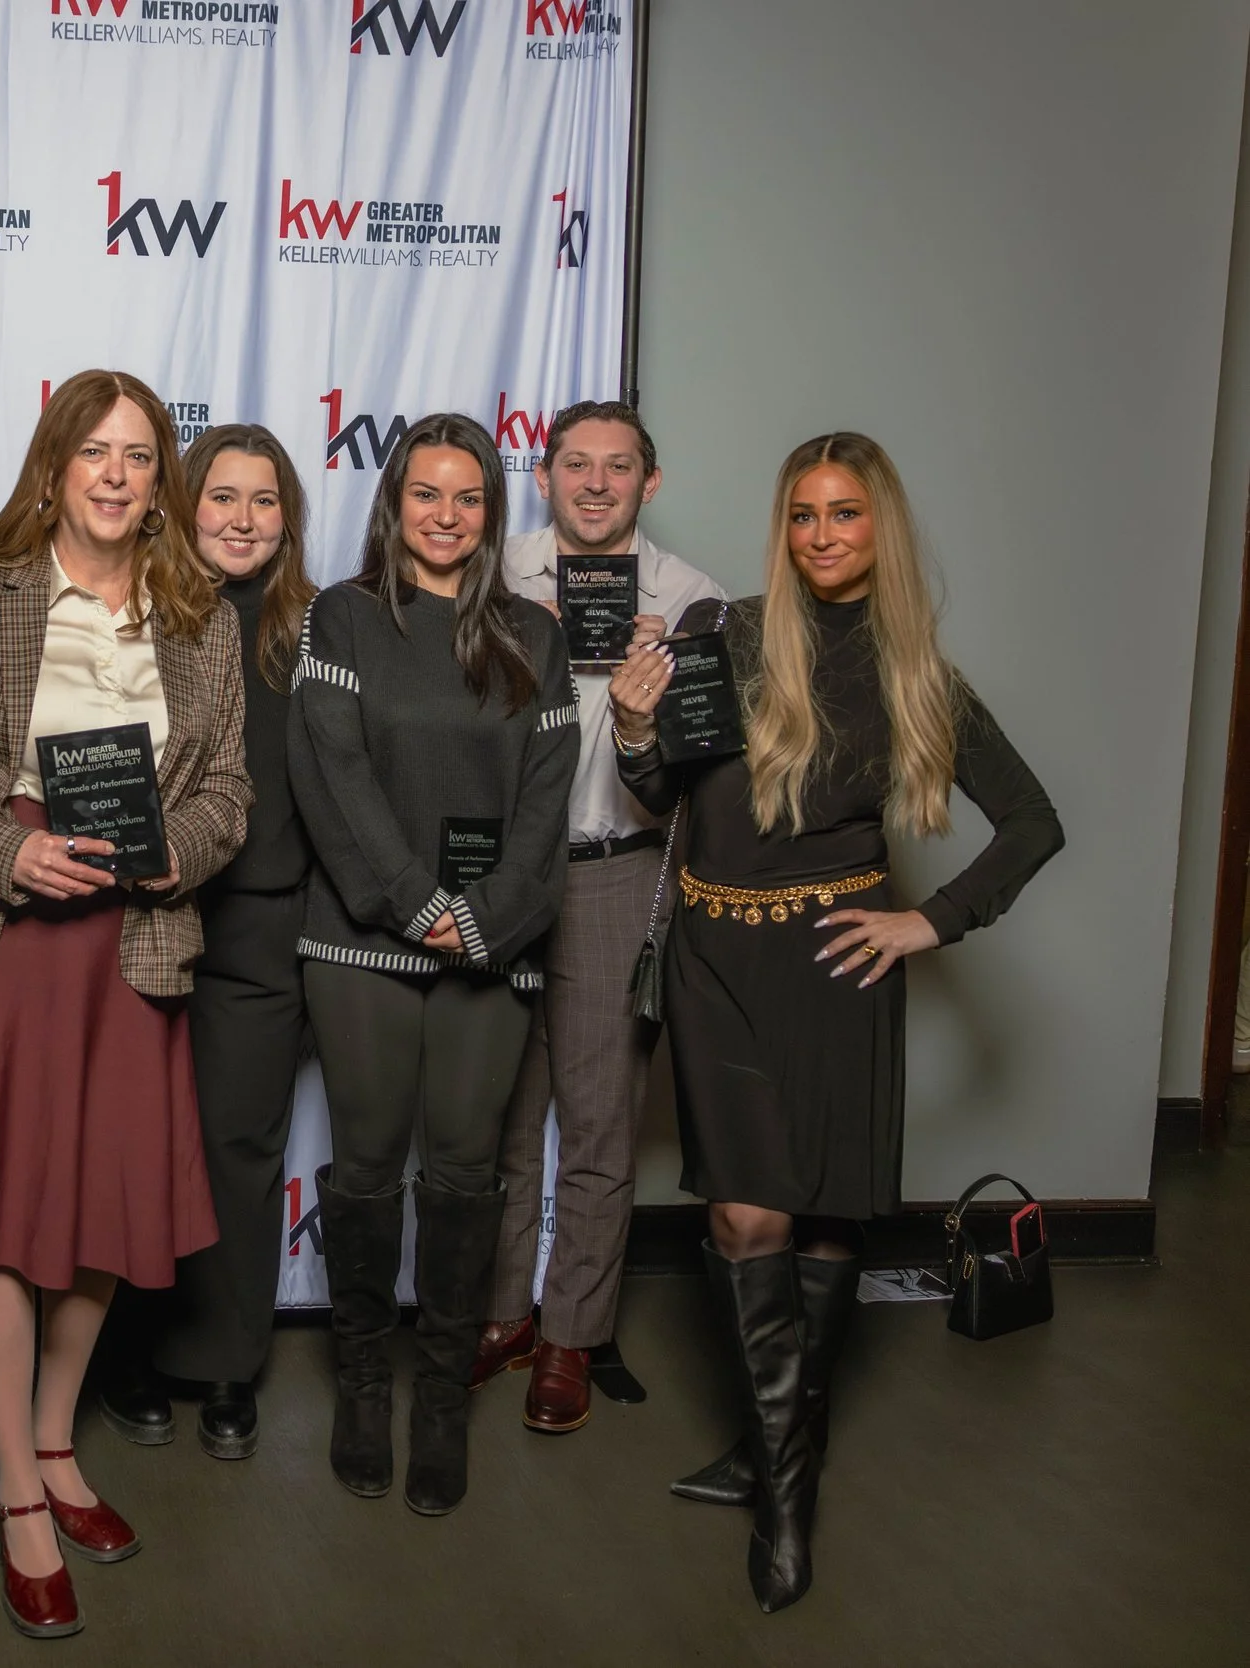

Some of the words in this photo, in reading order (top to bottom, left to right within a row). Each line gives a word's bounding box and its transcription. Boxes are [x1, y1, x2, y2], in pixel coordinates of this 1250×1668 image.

[141, 0, 279, 24] METROPOLITAN
[212, 28, 277, 47] REALTY
[366, 200, 444, 223] GREATER
[366, 222, 502, 245] METROPOLITAN
[429, 249, 499, 268] REALTY
[681, 695, 708, 706] SILVER
[86, 743, 118, 755] GREATER
[87, 747, 142, 763] METROPOLITAN
[114, 757, 142, 768] REALTY
[59, 784, 90, 795] Pinnacle
[91, 781, 99, 790] of
[100, 775, 146, 788] Performance
[90, 798, 121, 811] GOLD
[71, 823, 93, 833] Team
[94, 818, 116, 829] Sales
[116, 815, 146, 825] Volume
[100, 830, 120, 839] 2025
[125, 843, 148, 853] Team
